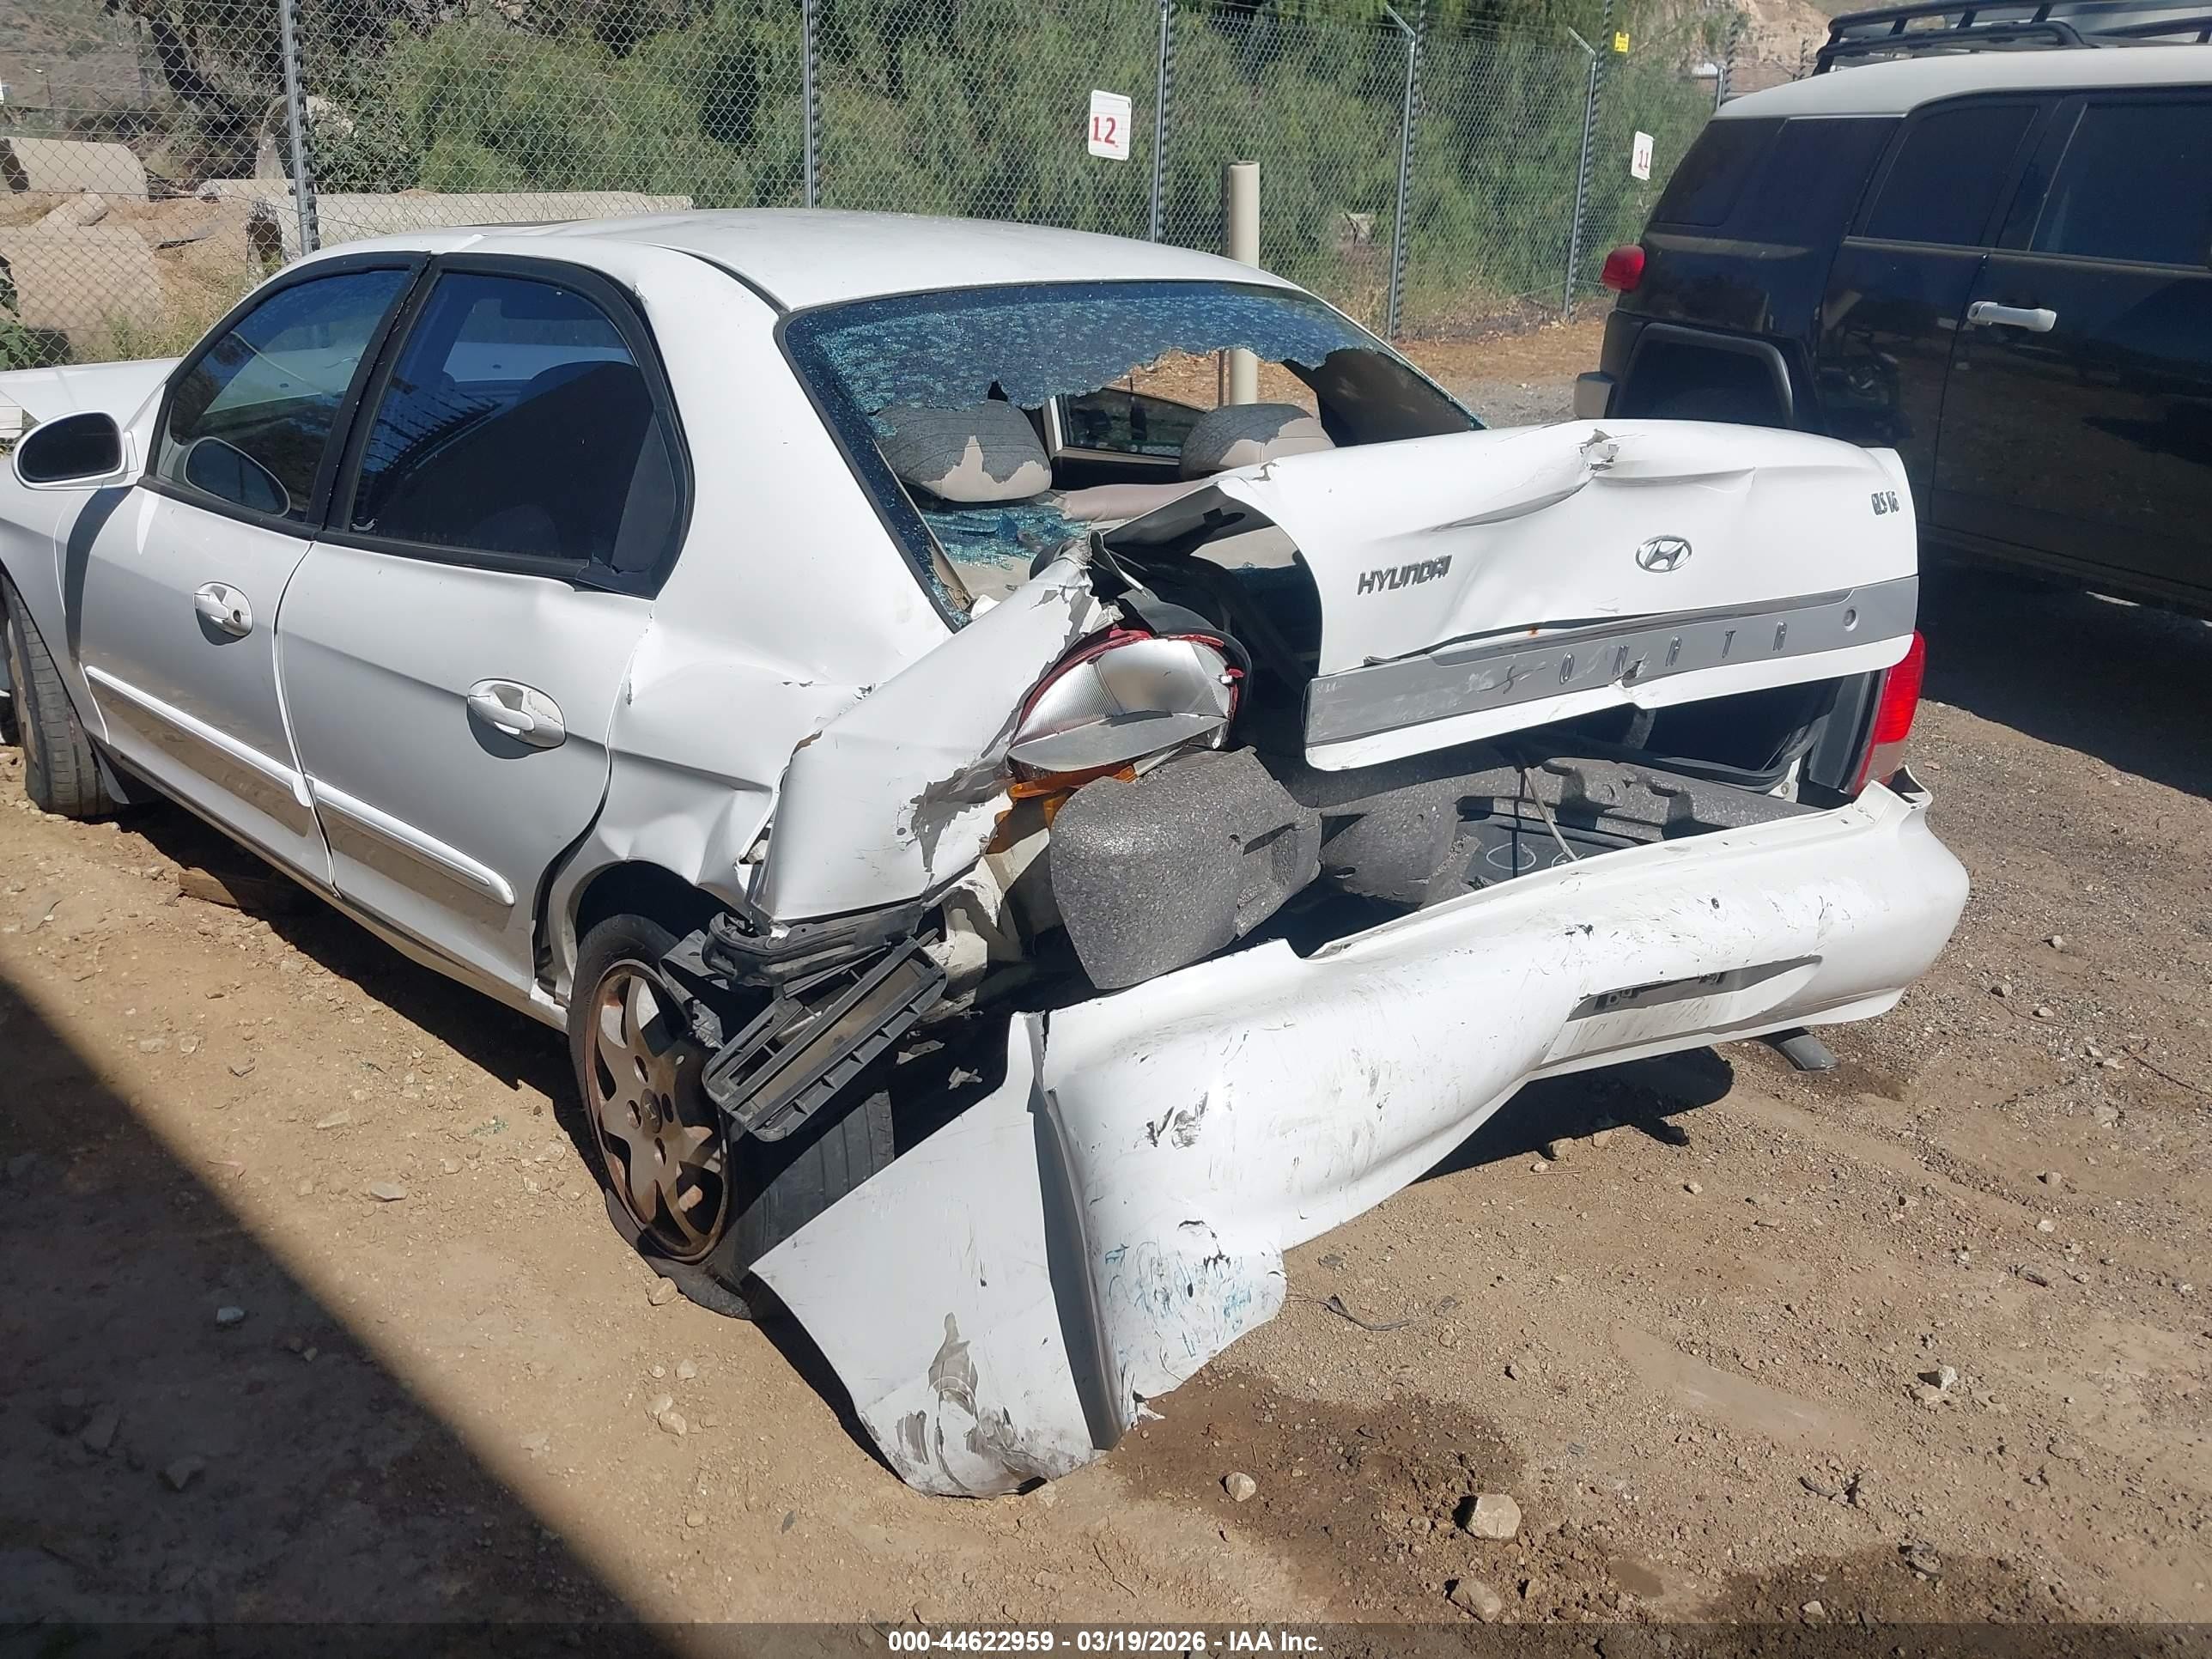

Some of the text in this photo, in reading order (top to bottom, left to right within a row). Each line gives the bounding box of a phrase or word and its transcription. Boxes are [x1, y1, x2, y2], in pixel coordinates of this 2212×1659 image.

[1092, 115, 1117, 145] 12
[1638, 149, 1650, 171] 11
[1357, 554, 1453, 596] HYUNDAI
